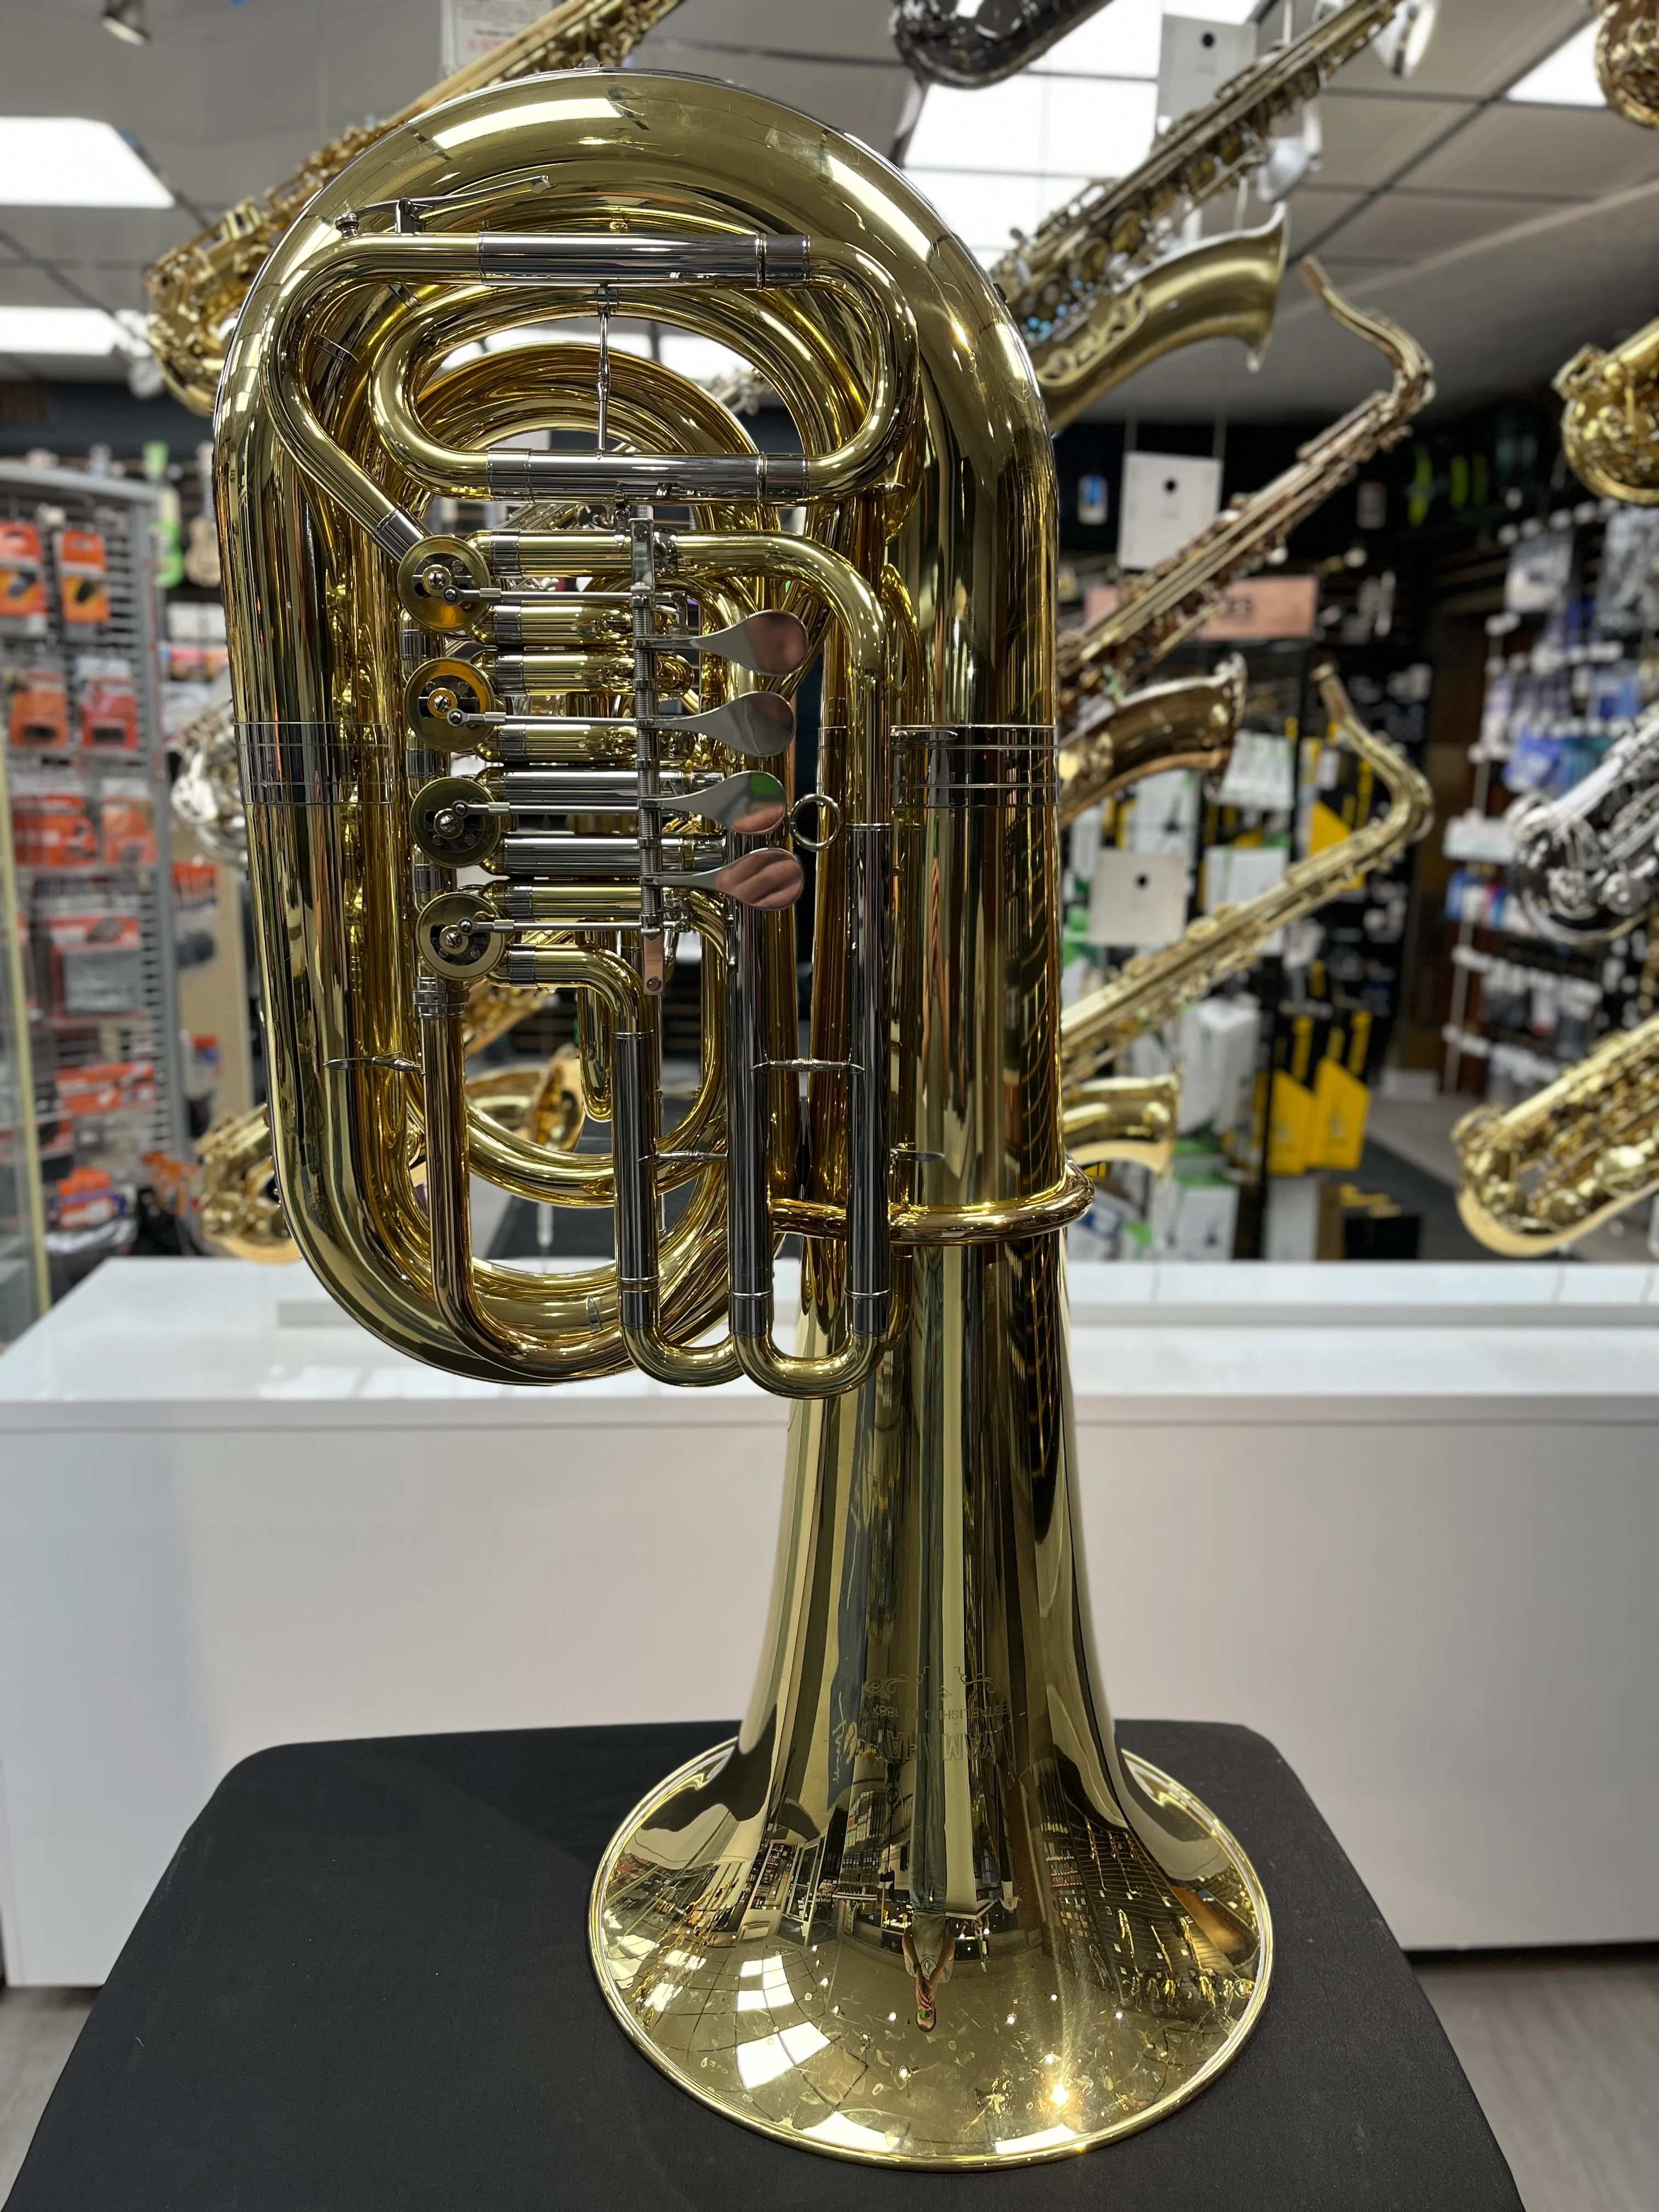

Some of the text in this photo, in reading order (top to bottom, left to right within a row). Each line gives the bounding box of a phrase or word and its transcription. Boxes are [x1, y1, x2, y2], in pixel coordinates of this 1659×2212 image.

[873, 1705, 900, 1718] 1887
[925, 1704, 1008, 1719] ESTABLISHED
[887, 1731, 995, 1761] YAMAHA
